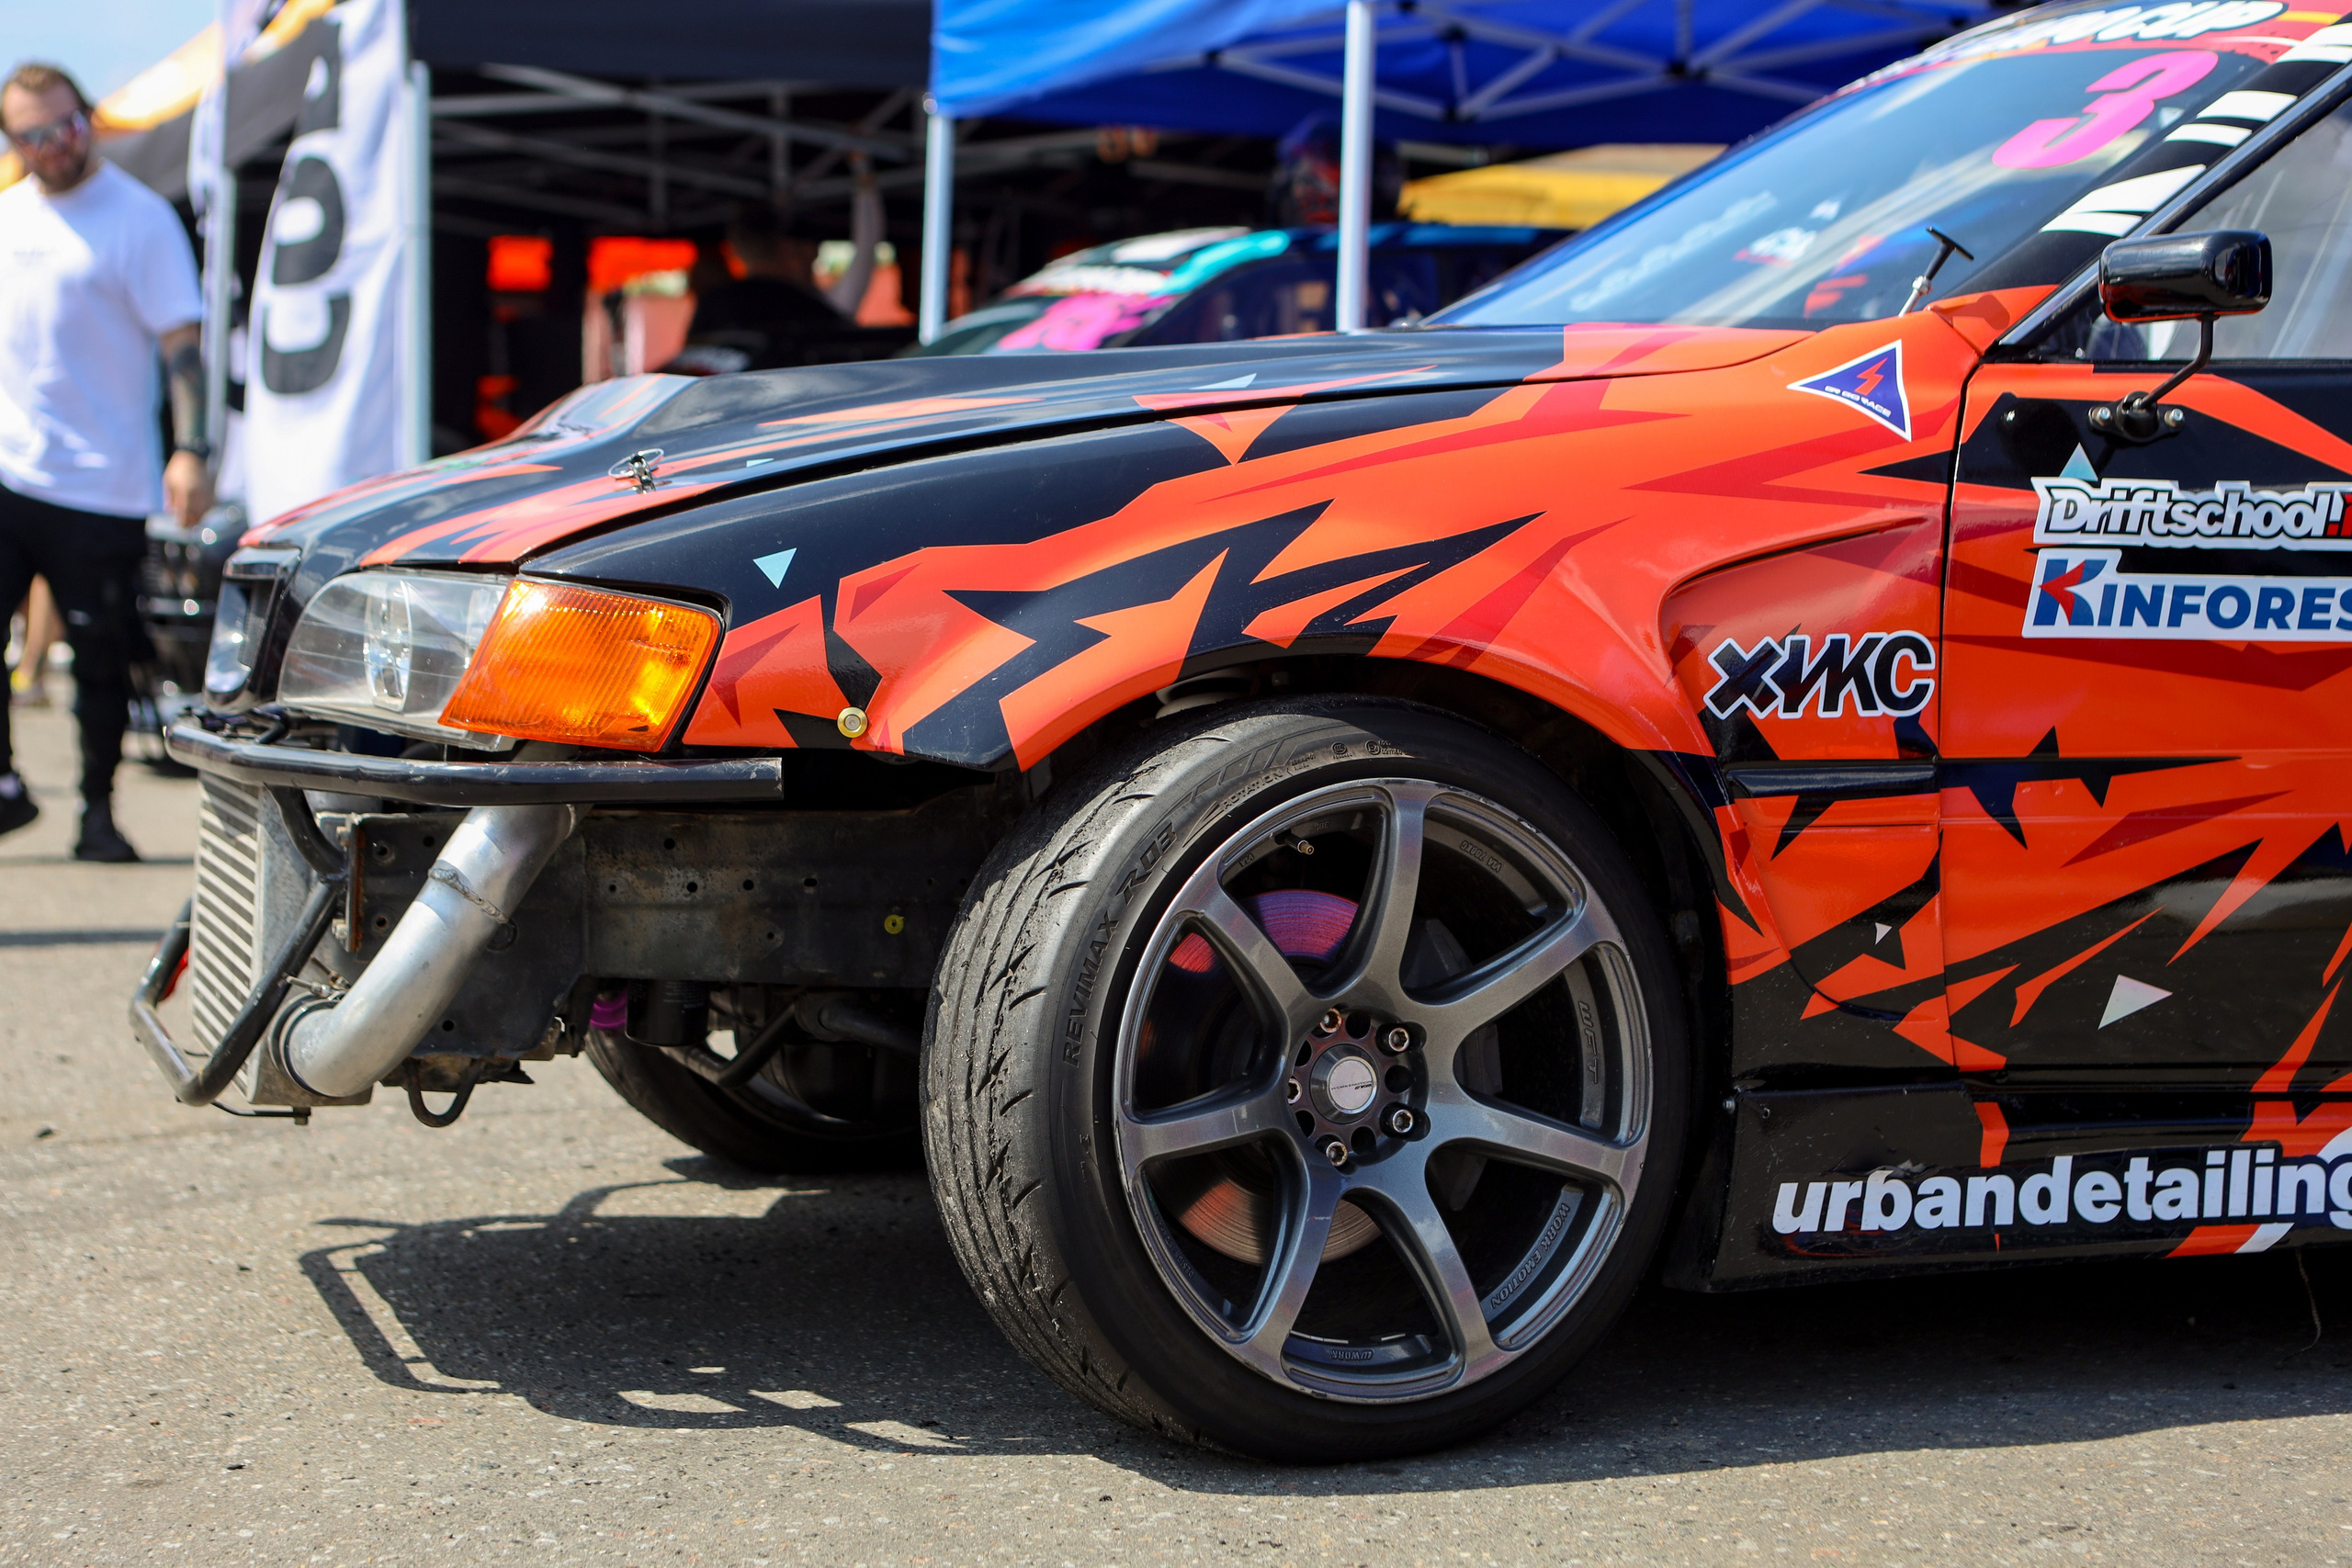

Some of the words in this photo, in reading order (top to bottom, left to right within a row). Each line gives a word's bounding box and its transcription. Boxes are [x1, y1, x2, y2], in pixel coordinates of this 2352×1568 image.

[1992, 50, 2219, 169] 3
[1062, 910, 1119, 1068] REVIMAX
[1540, 1202, 1571, 1251] WORK
[1490, 1248, 1543, 1310] EMOTION
